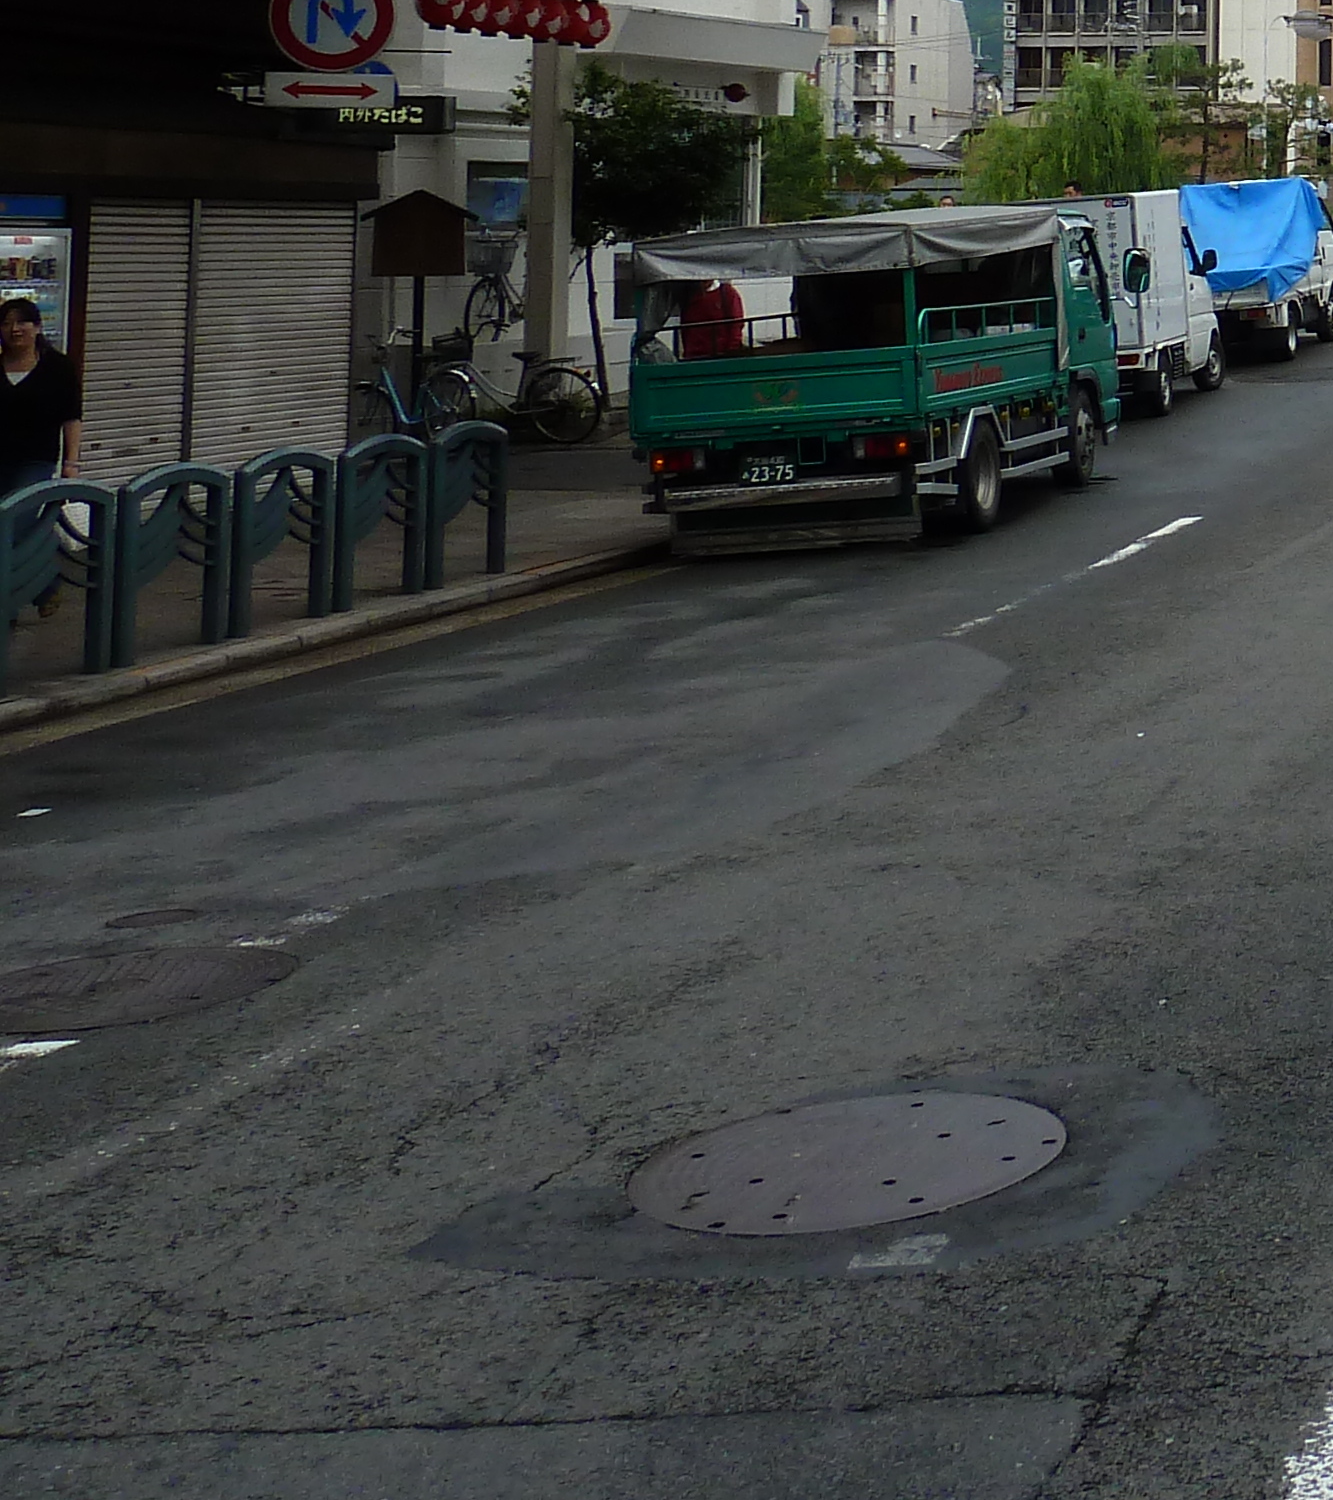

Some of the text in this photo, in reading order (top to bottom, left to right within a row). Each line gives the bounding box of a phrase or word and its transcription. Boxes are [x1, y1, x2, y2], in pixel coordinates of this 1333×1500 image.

[338, 105, 424, 124] 内外たばこ
[750, 464, 795, 482] 23-75
